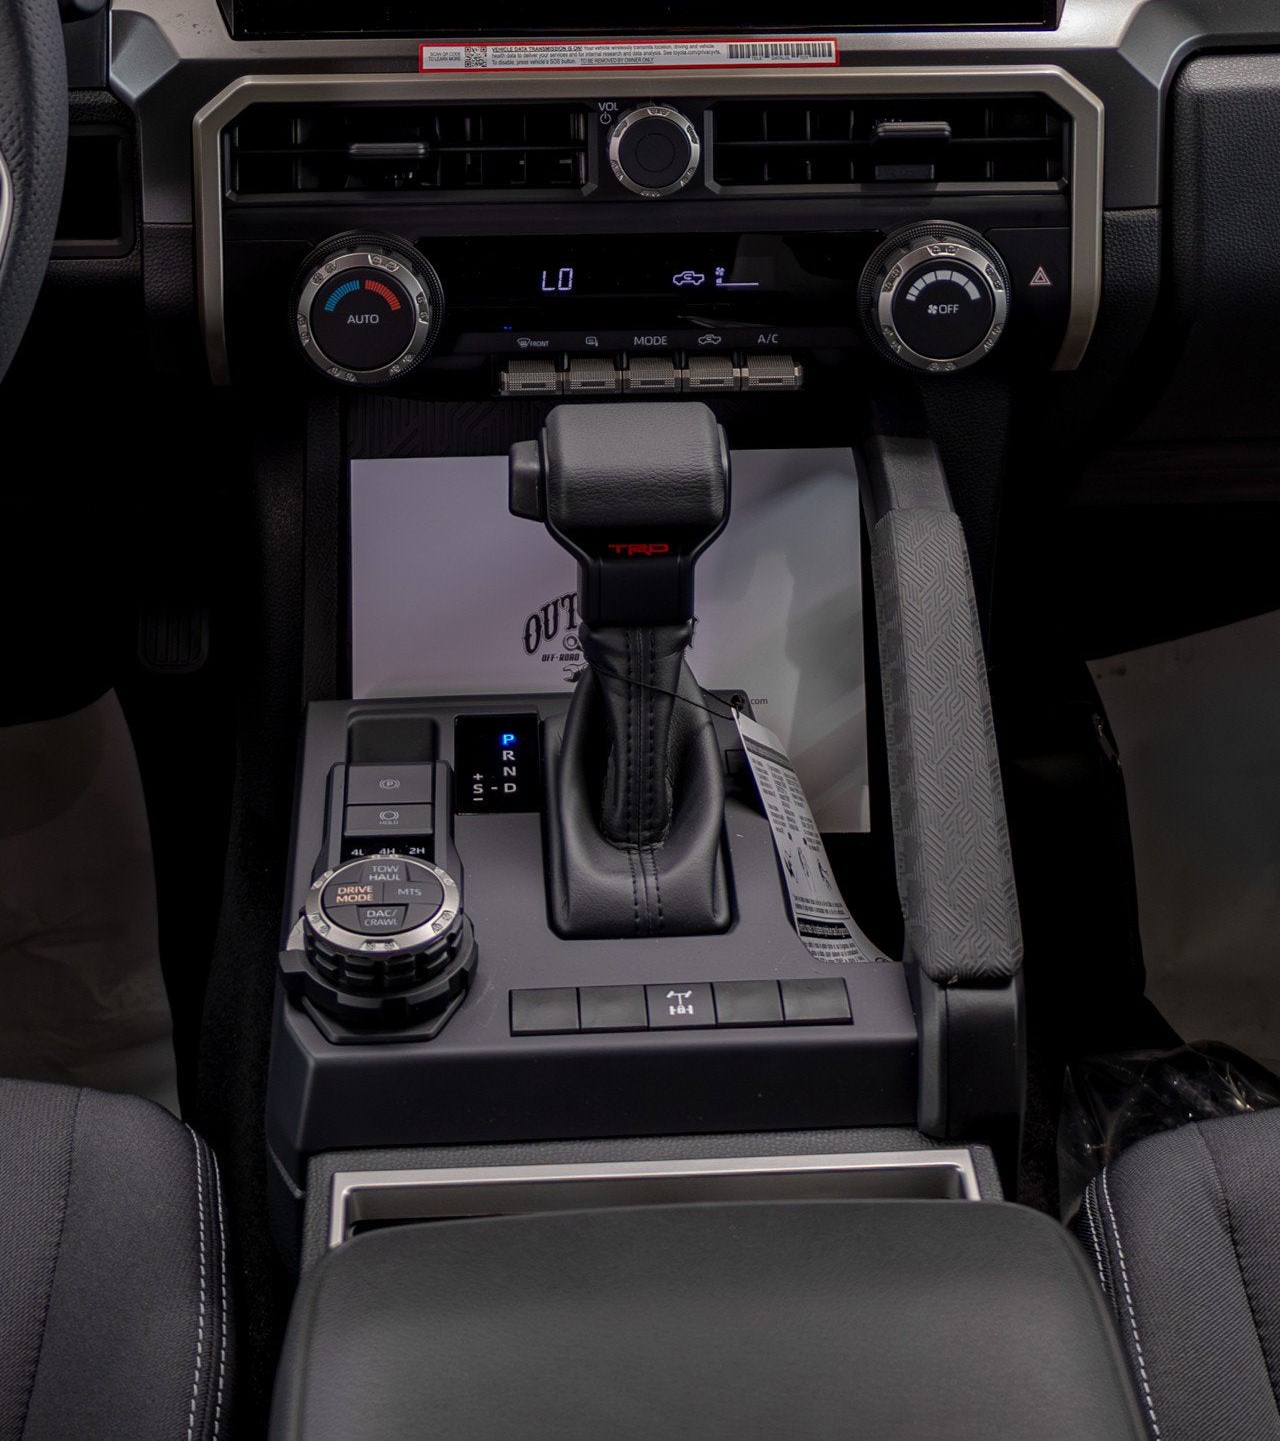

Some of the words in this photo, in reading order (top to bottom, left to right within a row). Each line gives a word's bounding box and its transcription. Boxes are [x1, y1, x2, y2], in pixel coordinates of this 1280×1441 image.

[598, 102, 618, 111] VOL
[541, 267, 574, 291] LO
[938, 304, 959, 314] OFF
[347, 314, 379, 324] AUTO
[634, 335, 668, 345] MODE
[757, 334, 779, 344] A/C
[608, 543, 669, 555] TRD
[542, 653, 579, 662] OFF-ROAD
[503, 734, 515, 745] P
[502, 750, 515, 761] R
[503, 766, 517, 776] N
[473, 783, 484, 793] S
[504, 783, 517, 793] D
[372, 865, 400, 873] TOW
[369, 873, 401, 881] HAUL
[337, 885, 373, 894] DRIVE
[398, 888, 422, 896] MTS
[336, 894, 373, 903] MODE
[367, 909, 396, 918] DAC/
[364, 918, 398, 926] CRAWL
